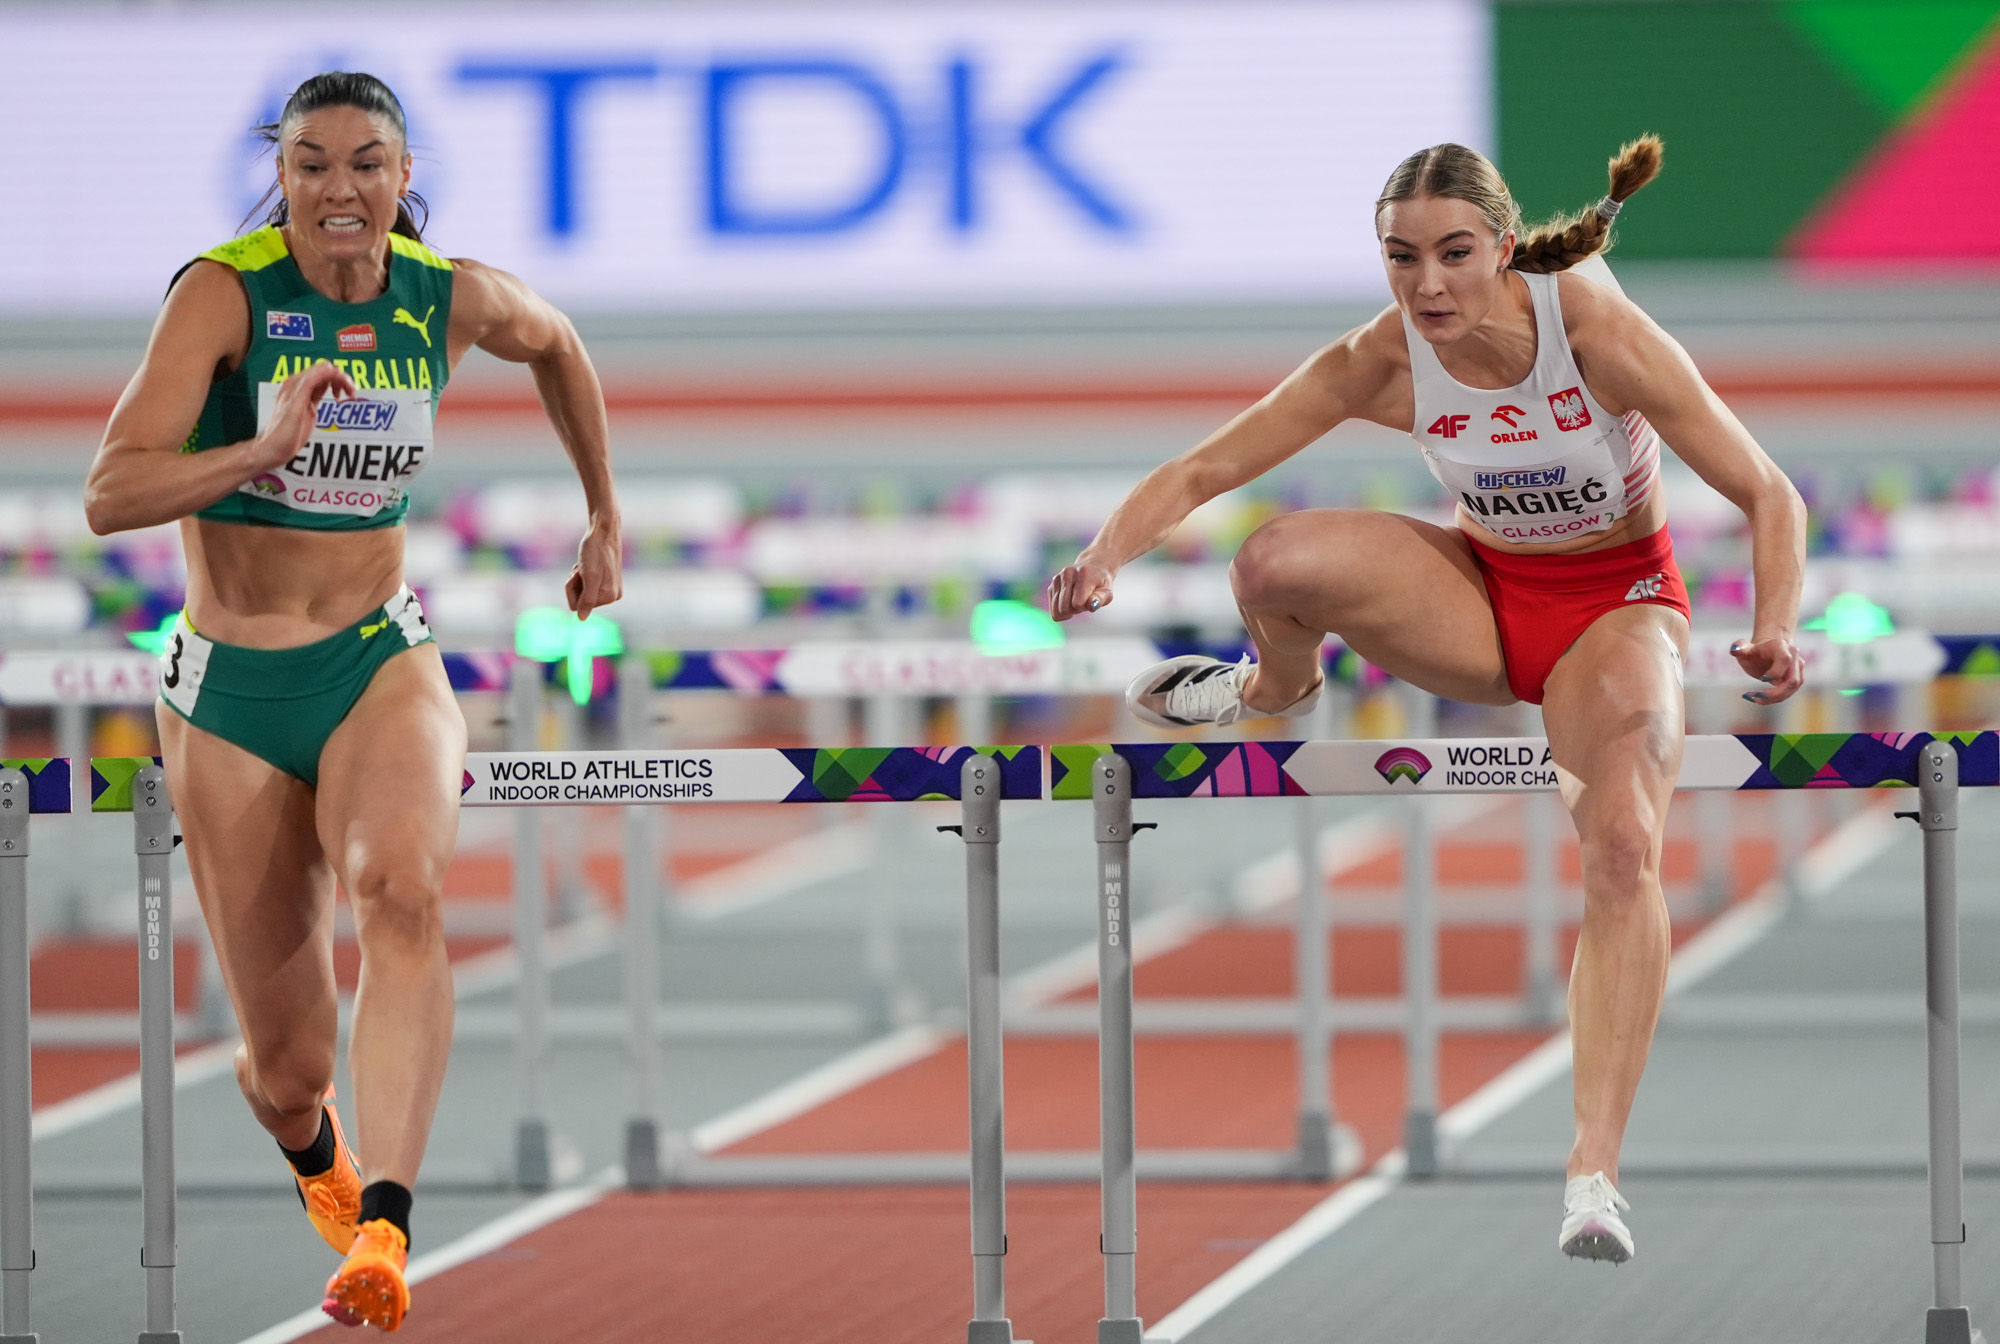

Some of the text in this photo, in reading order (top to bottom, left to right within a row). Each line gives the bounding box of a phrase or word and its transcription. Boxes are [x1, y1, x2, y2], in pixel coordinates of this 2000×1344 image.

[450, 50, 1142, 238] TDK
[339, 333, 373, 342] CHEMIST
[271, 354, 433, 390] ATRALIA
[1427, 414, 1471, 438] 4F
[1490, 430, 1538, 443] ORLEN
[285, 442, 424, 481] ENNEKE
[1474, 466, 1566, 489] HI-CHEW
[1461, 477, 1607, 516] NAGIĘĆ
[1502, 515, 1600, 538] GLASGOW
[1624, 573, 1662, 601] 4F
[53, 658, 158, 699] GLAS
[1447, 747, 1533, 766] WORLD
[489, 759, 713, 780] WORLD ATHLETICS
[1446, 771, 1516, 785] INDOOR
[489, 783, 713, 800] INDOOR CHAMPIONSHIPS
[1105, 882, 1121, 946] MONDO
[145, 896, 160, 960] MONDO
